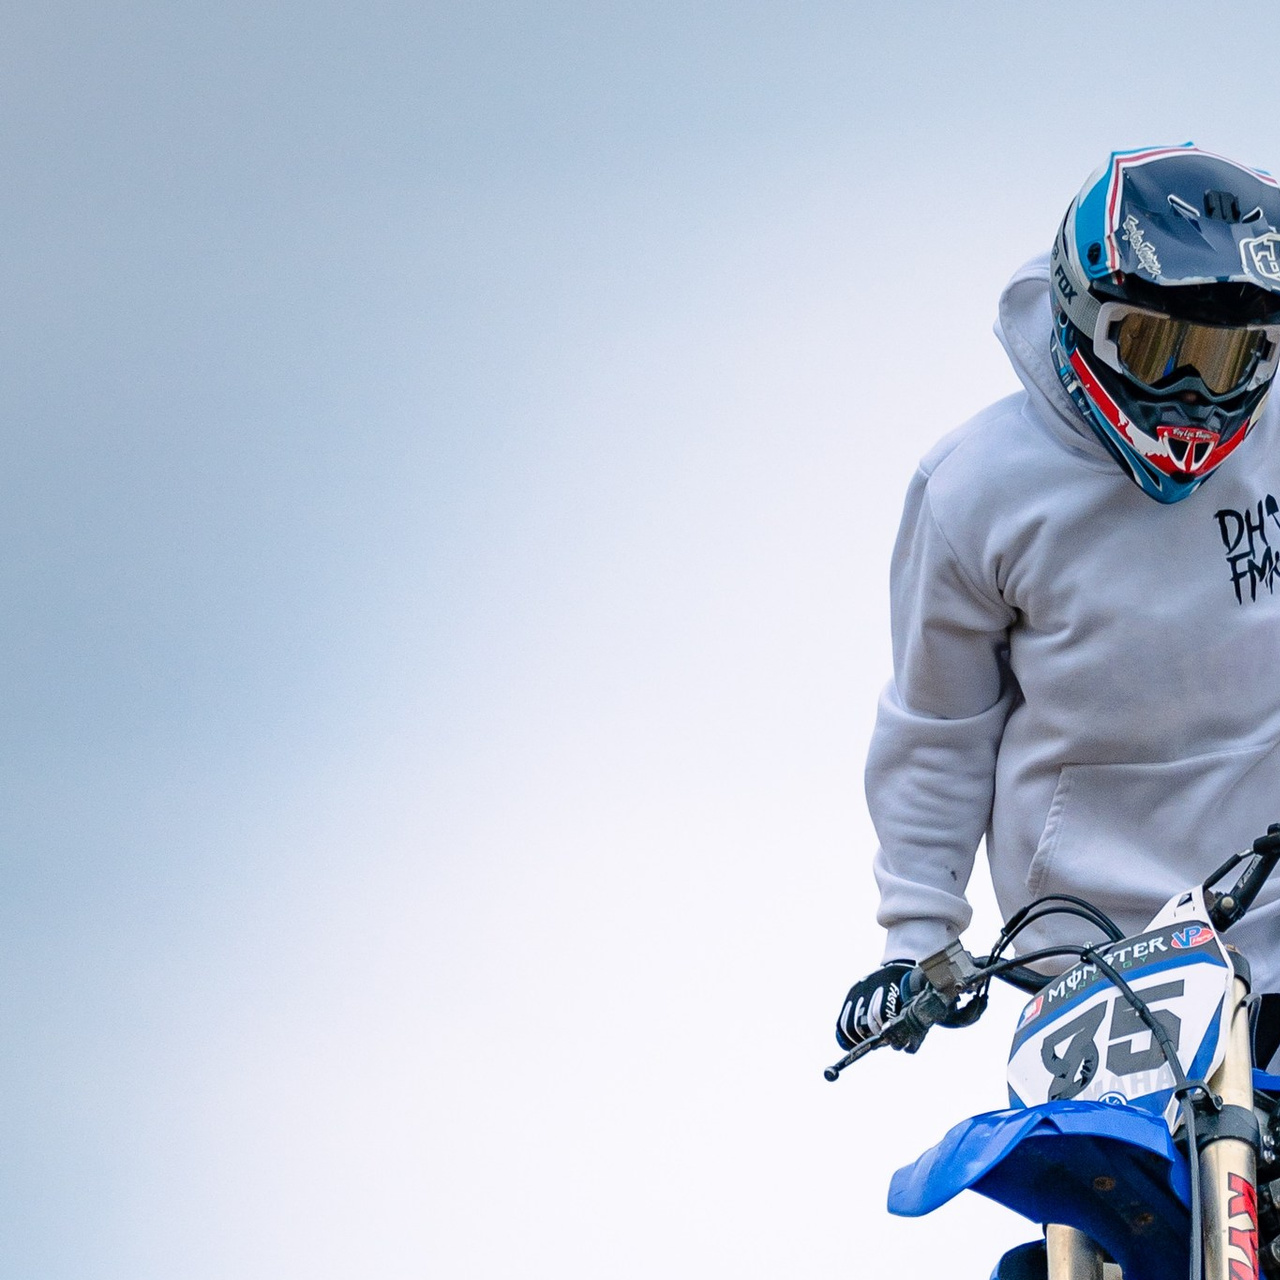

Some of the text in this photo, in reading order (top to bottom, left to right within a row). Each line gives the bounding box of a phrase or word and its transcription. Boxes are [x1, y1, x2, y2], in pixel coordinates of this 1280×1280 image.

[1054, 265, 1078, 305] FOX
[1213, 499, 1269, 560] DH
[1171, 925, 1202, 949] VP
[1065, 955, 1149, 1000] ENEGY
[1040, 978, 1185, 1102] 85
